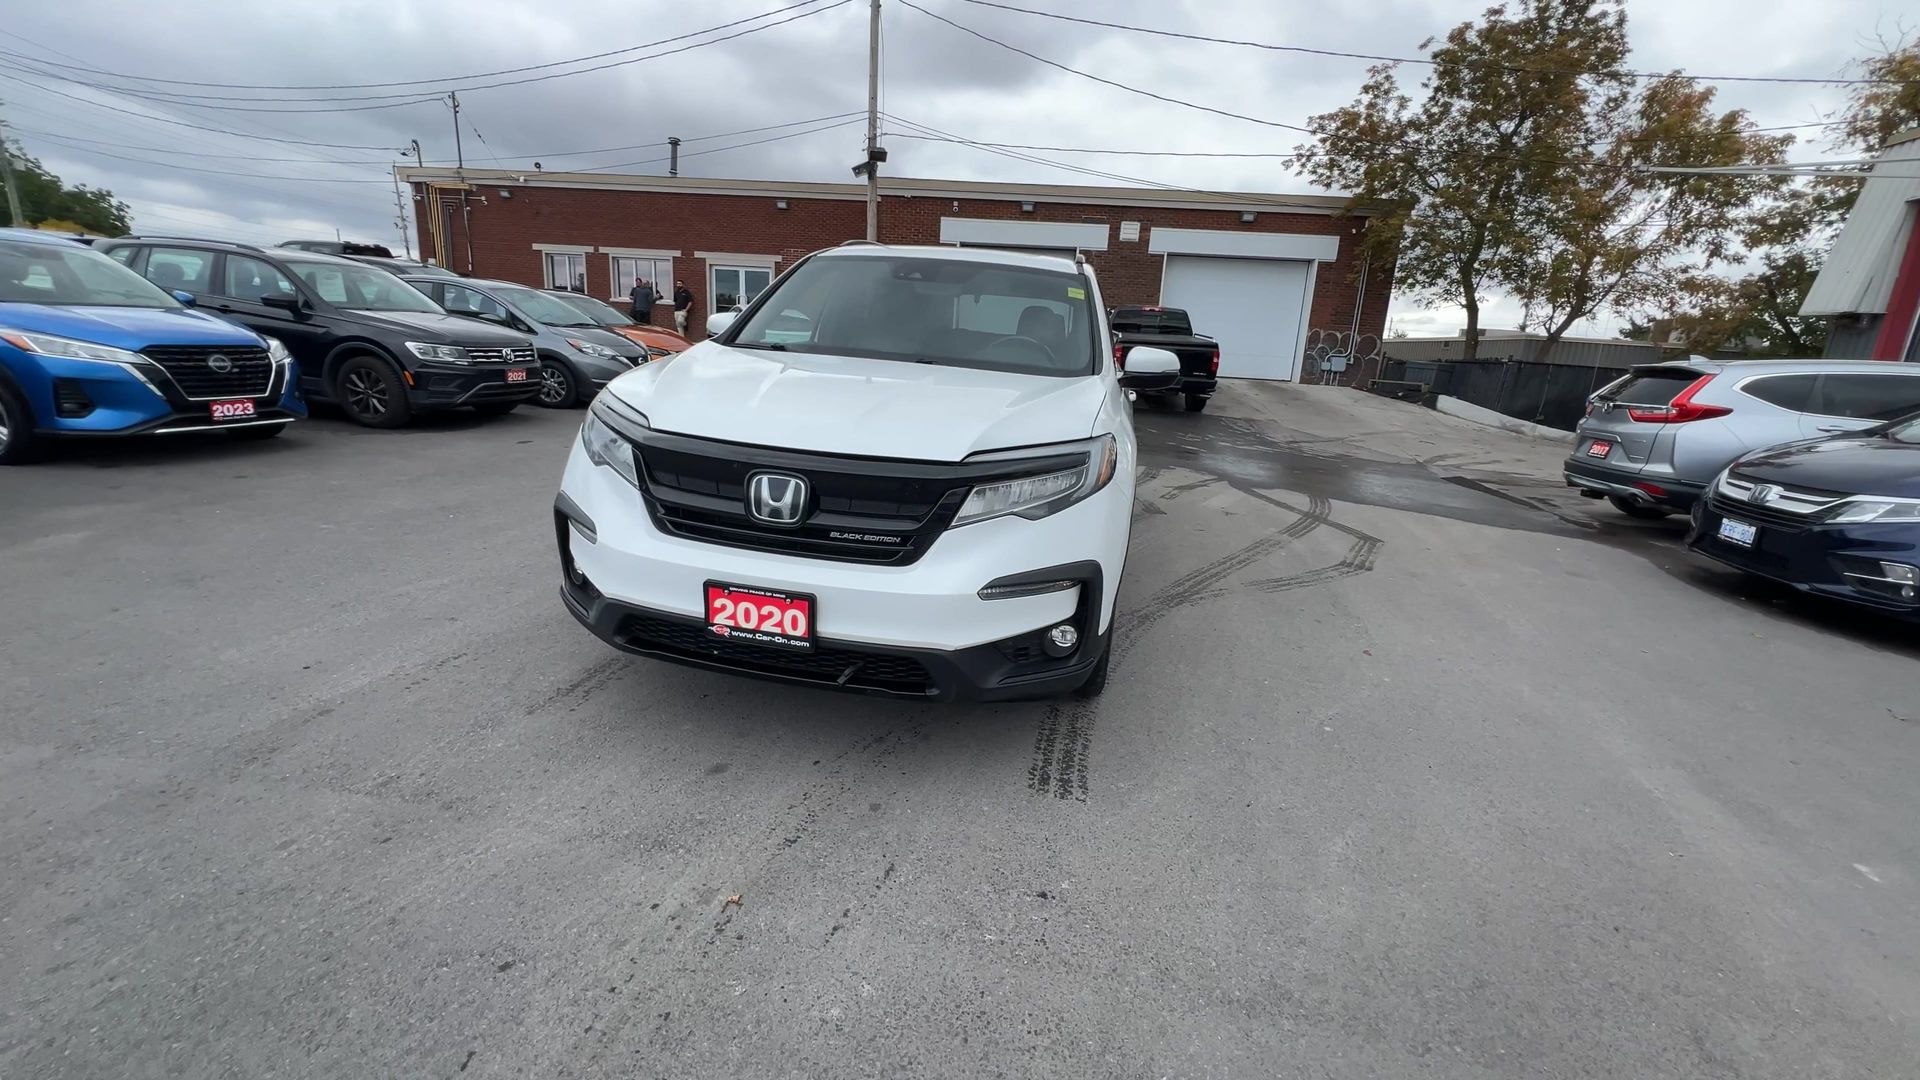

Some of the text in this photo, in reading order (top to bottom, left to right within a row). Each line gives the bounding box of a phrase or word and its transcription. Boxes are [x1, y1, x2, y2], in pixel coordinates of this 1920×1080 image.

[507, 371, 527, 381] 2021
[212, 402, 254, 417] 2023
[1589, 444, 1610, 455] 2017
[829, 531, 901, 543] BLACK EDITION
[713, 597, 806, 637] 2020
[731, 630, 810, 648] www.Car-On.com
